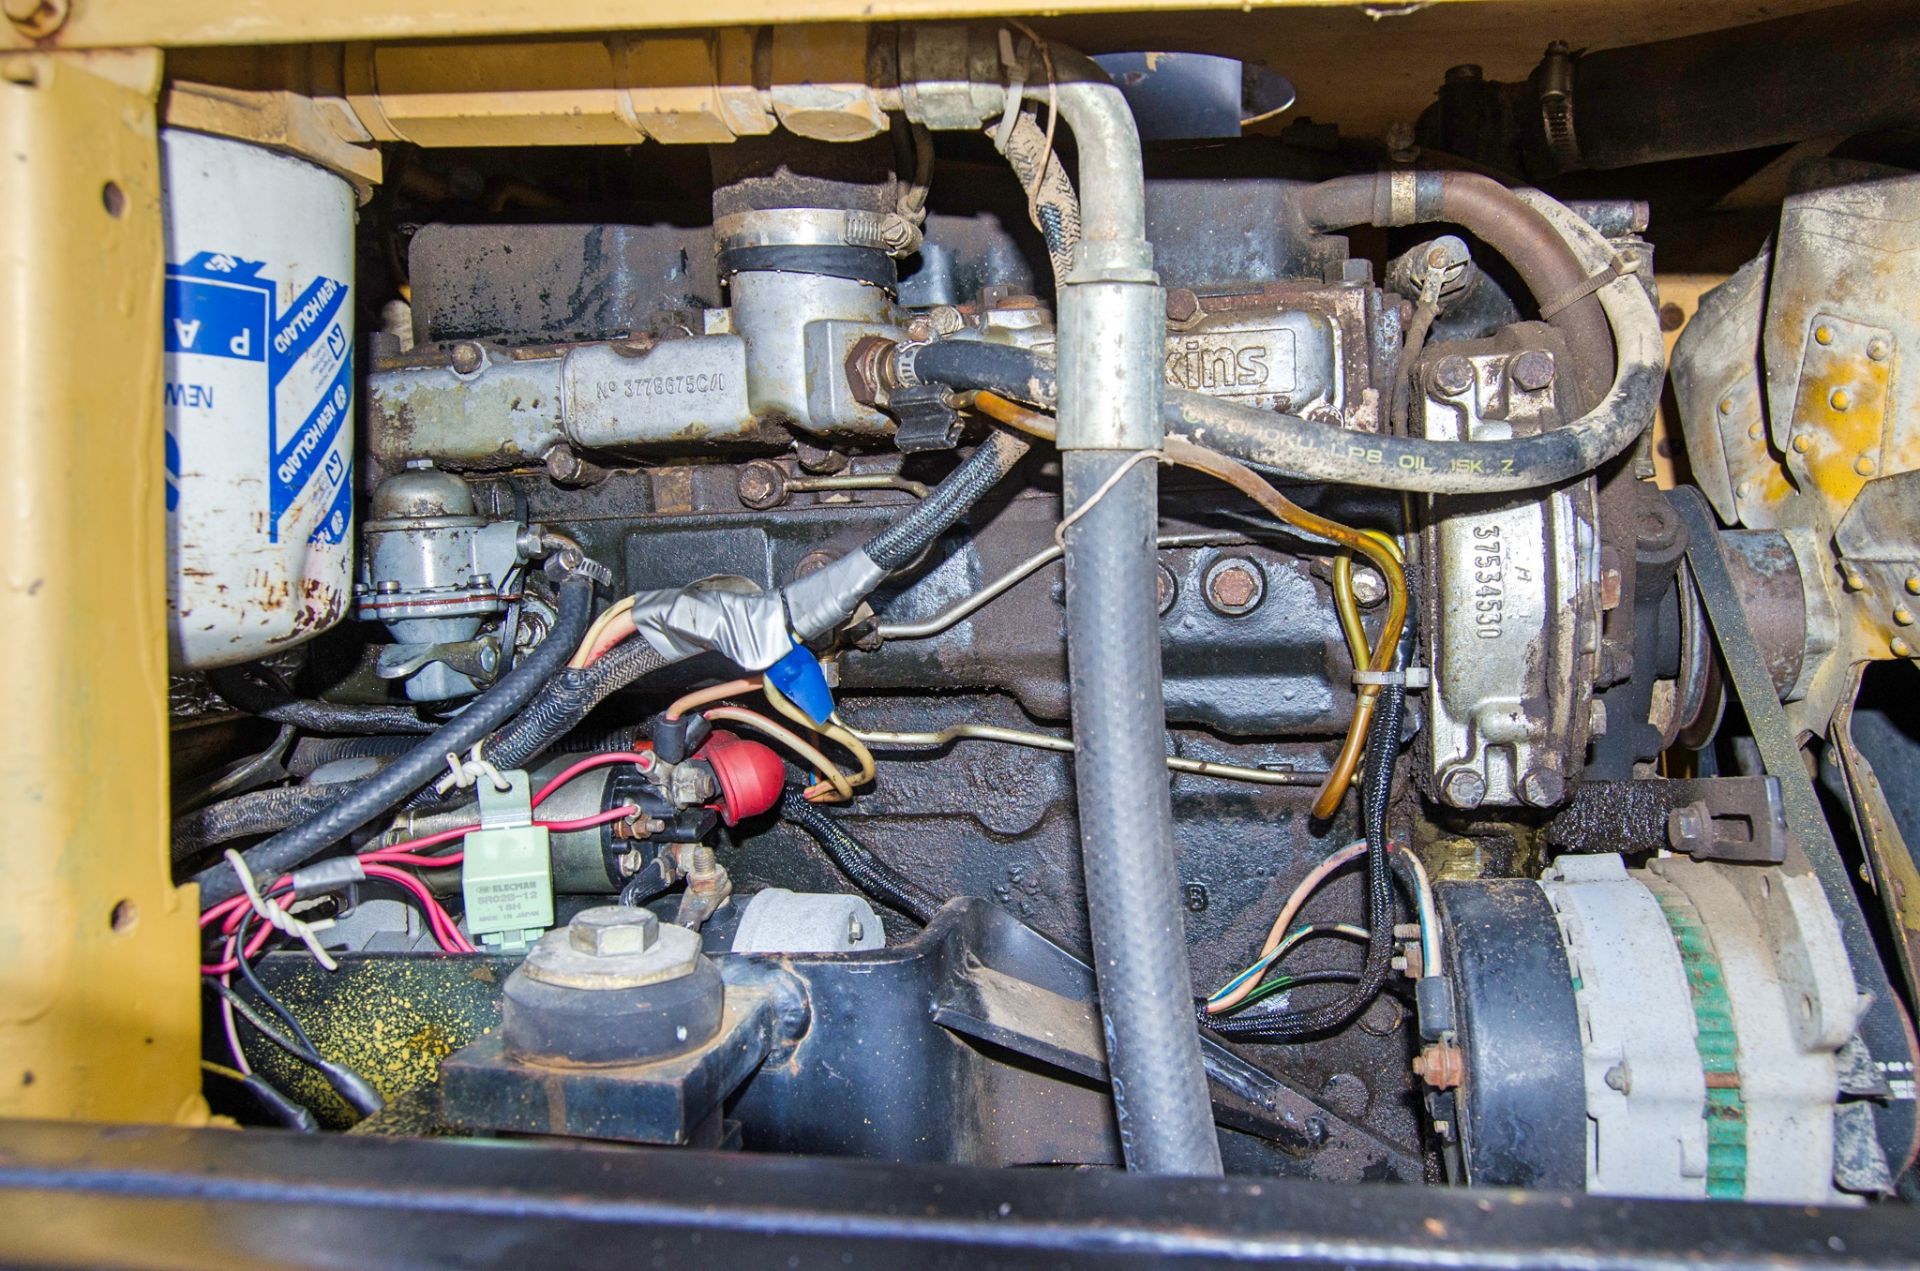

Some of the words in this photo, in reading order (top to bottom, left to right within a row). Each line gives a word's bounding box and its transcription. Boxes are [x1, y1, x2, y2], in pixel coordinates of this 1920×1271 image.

[164, 382, 214, 409] NEW
[1399, 454, 1433, 472] OIL
[1473, 525, 1503, 640] 37534530
